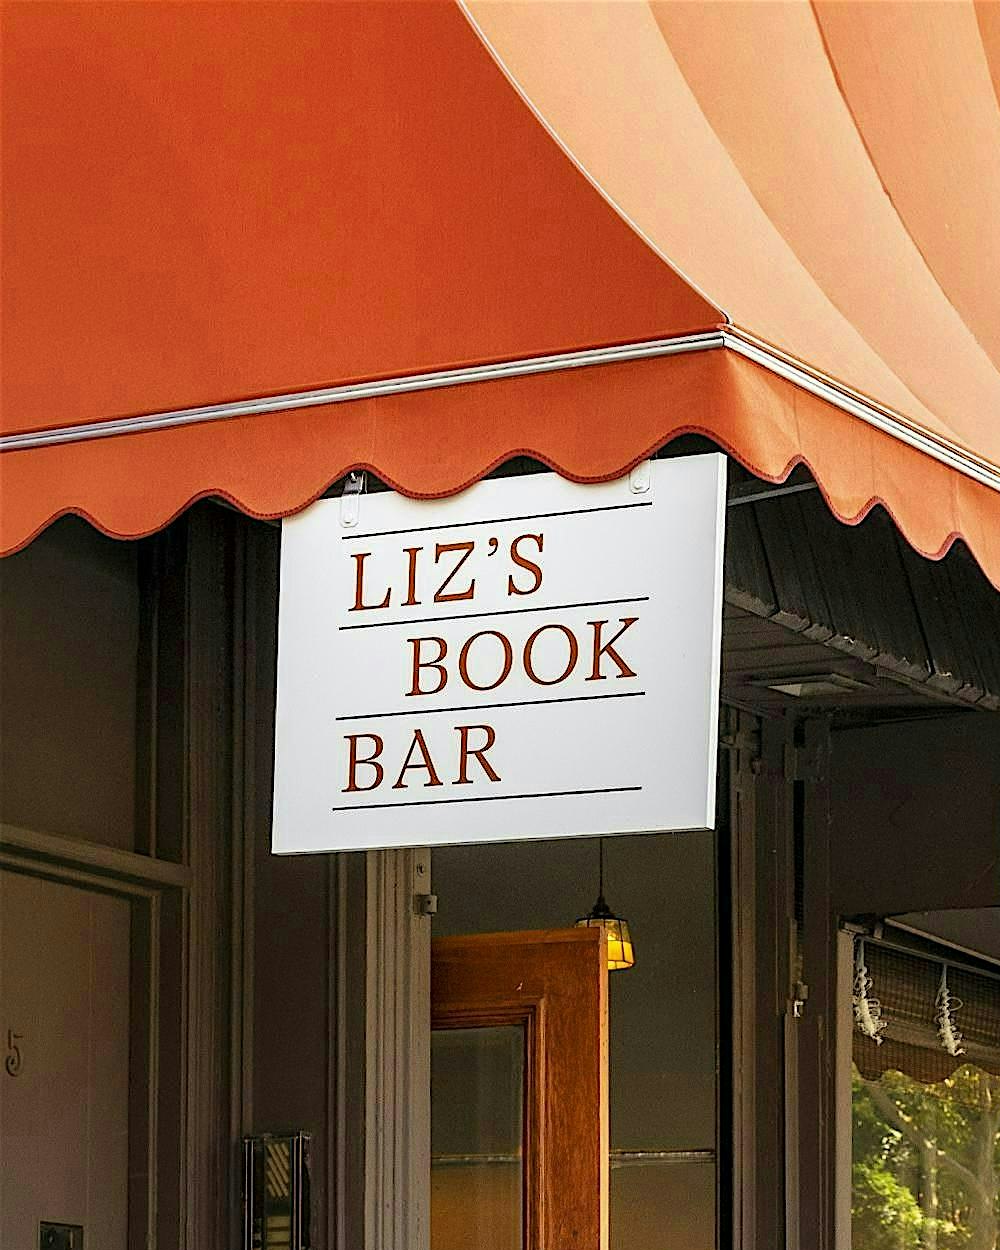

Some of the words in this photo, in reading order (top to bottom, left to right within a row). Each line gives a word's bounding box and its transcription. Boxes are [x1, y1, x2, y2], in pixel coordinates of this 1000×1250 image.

[347, 532, 545, 613] LIZ'S
[404, 616, 640, 698] BOOK
[341, 723, 502, 794] BAR
